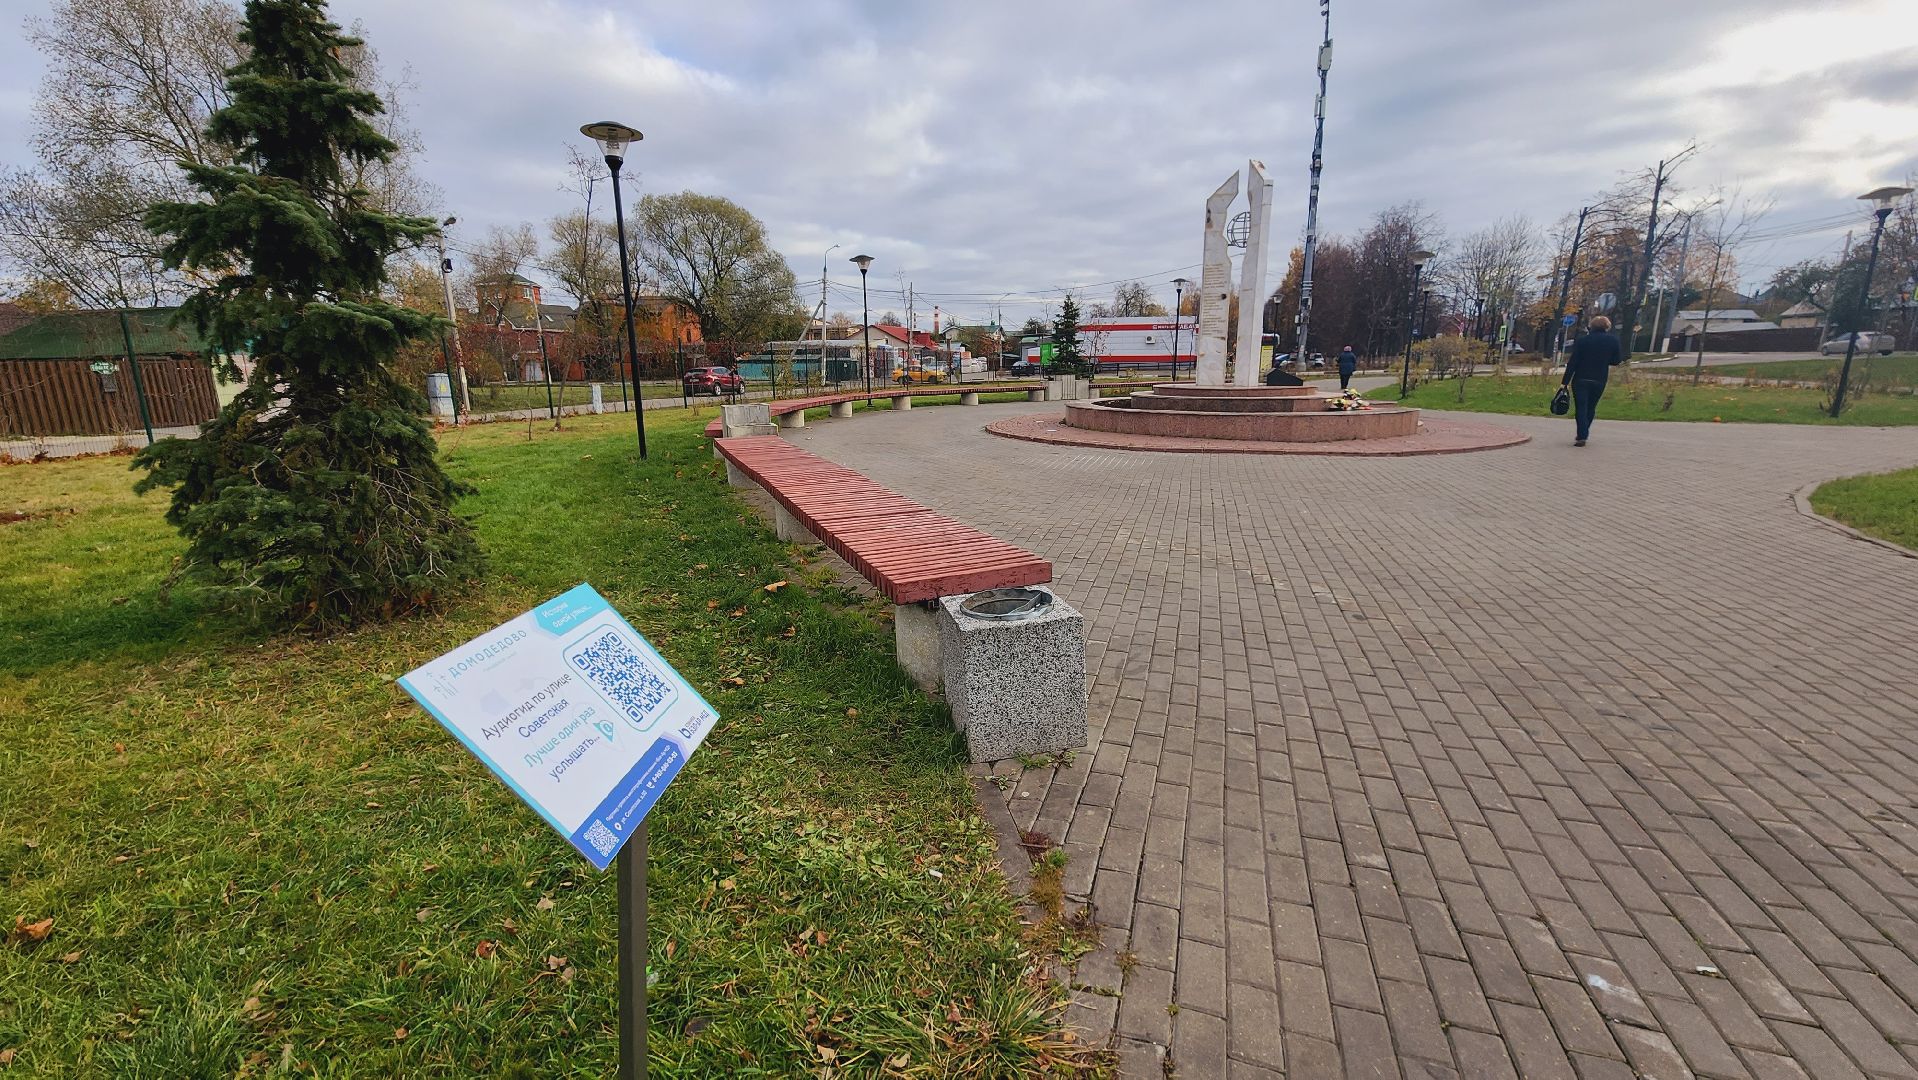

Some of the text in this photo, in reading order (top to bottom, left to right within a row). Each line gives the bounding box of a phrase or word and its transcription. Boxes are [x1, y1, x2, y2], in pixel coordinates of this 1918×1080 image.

[448, 630, 527, 678] ДОМОДЕДОВО
[481, 673, 572, 740] Аудиогид по улице
[518, 698, 569, 738] Советская
[523, 706, 596, 767] Лучше один раз
